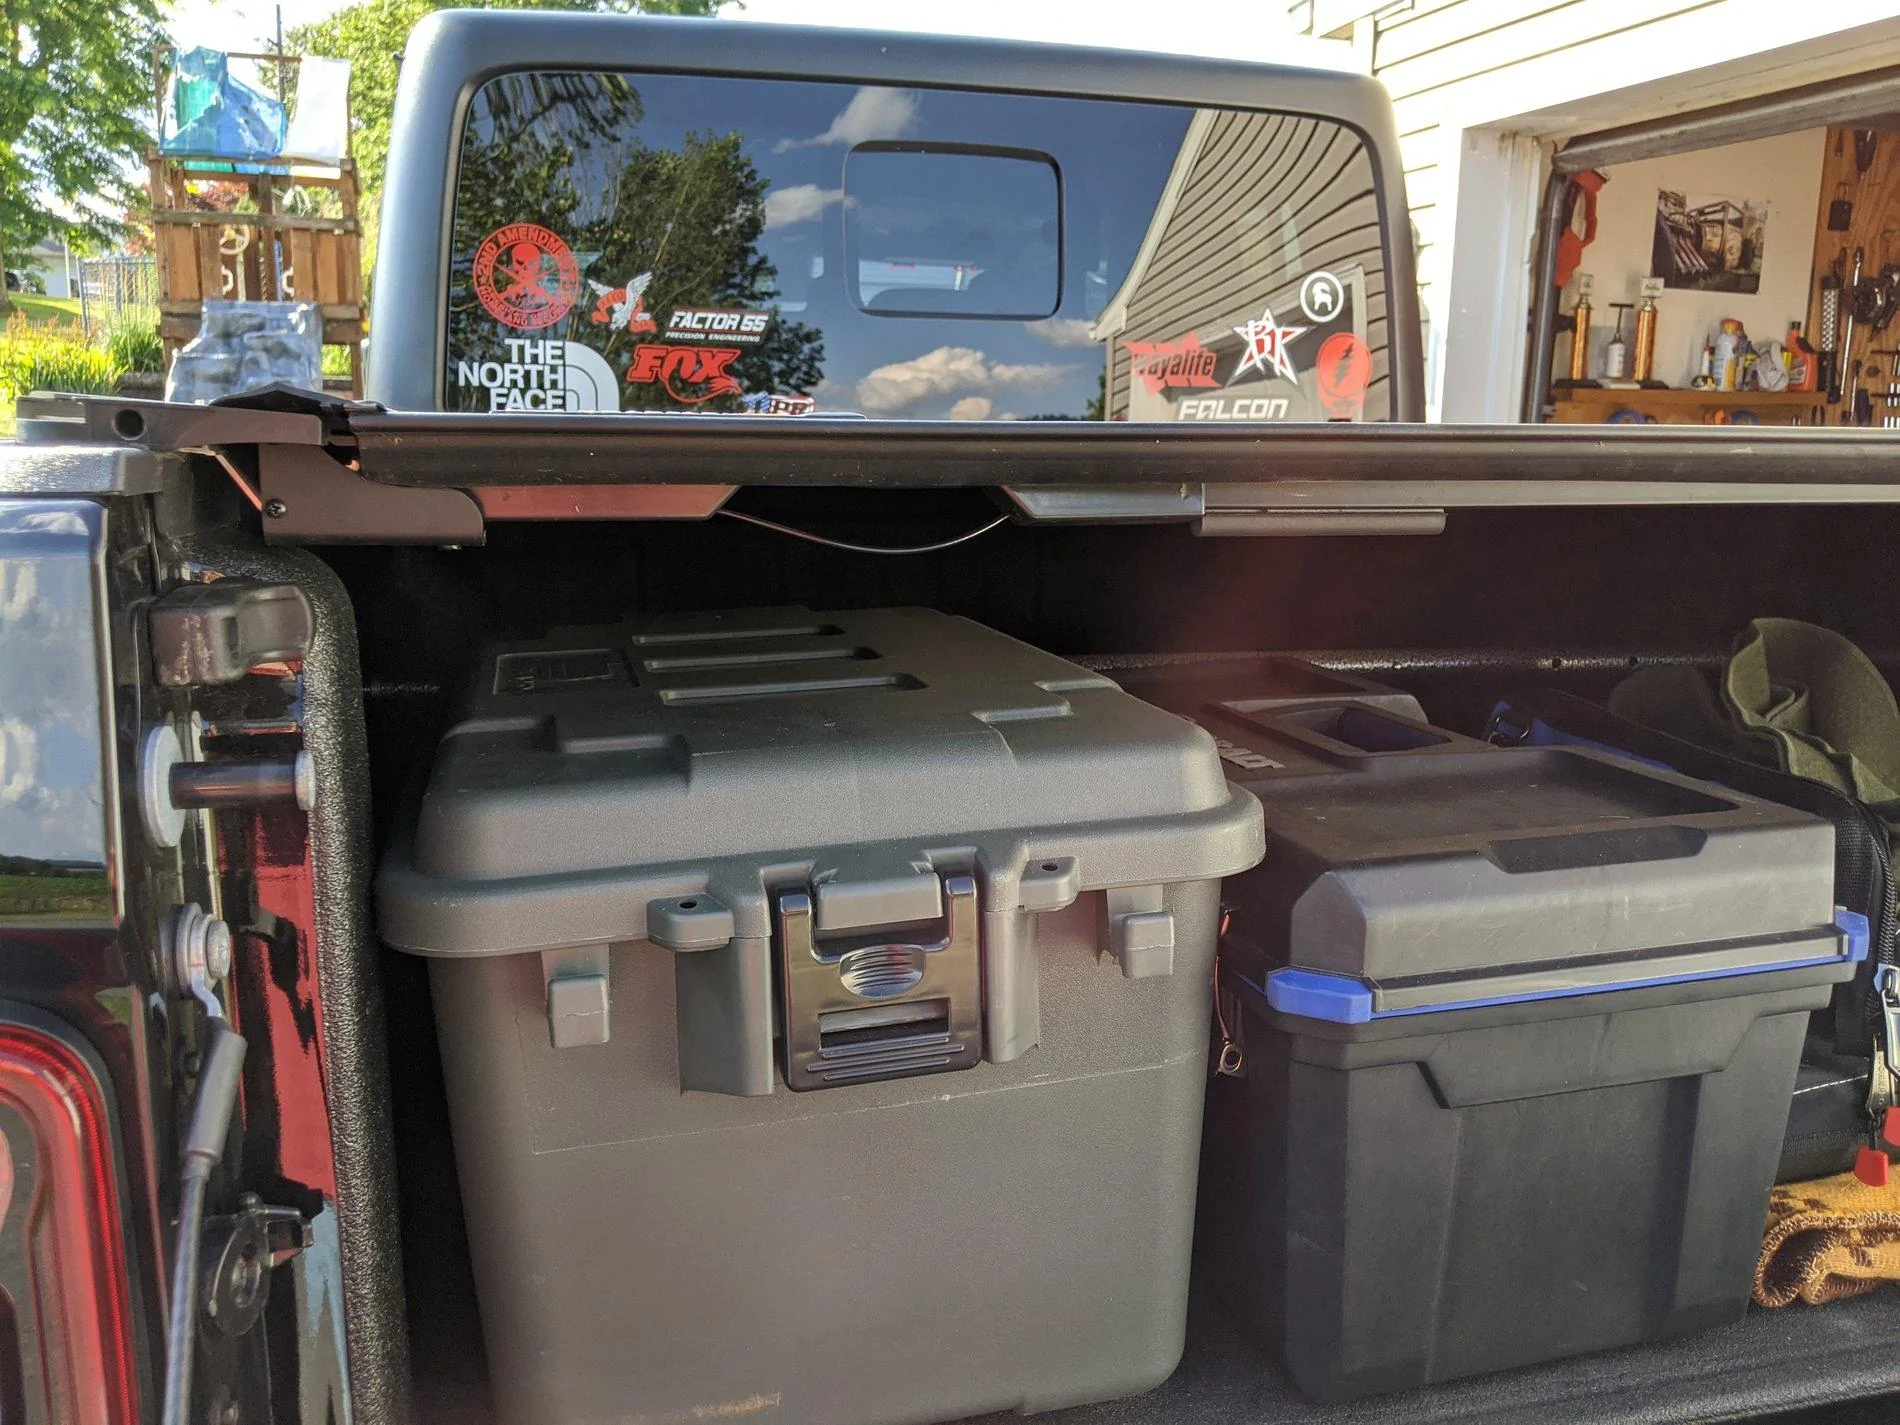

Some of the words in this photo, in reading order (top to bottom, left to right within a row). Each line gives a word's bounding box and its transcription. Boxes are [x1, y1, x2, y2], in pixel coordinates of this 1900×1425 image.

[477, 241, 498, 282] 2ND
[497, 227, 577, 279] AMENDME
[669, 311, 741, 331] FACTOR
[665, 331, 706, 340] PRECISION
[708, 333, 761, 342] ENGINEERING
[504, 338, 564, 365] THE
[458, 361, 564, 389] NORTH
[627, 344, 741, 390] FOX
[489, 388, 565, 411] FACE
[1178, 399, 1289, 420] FALCON
